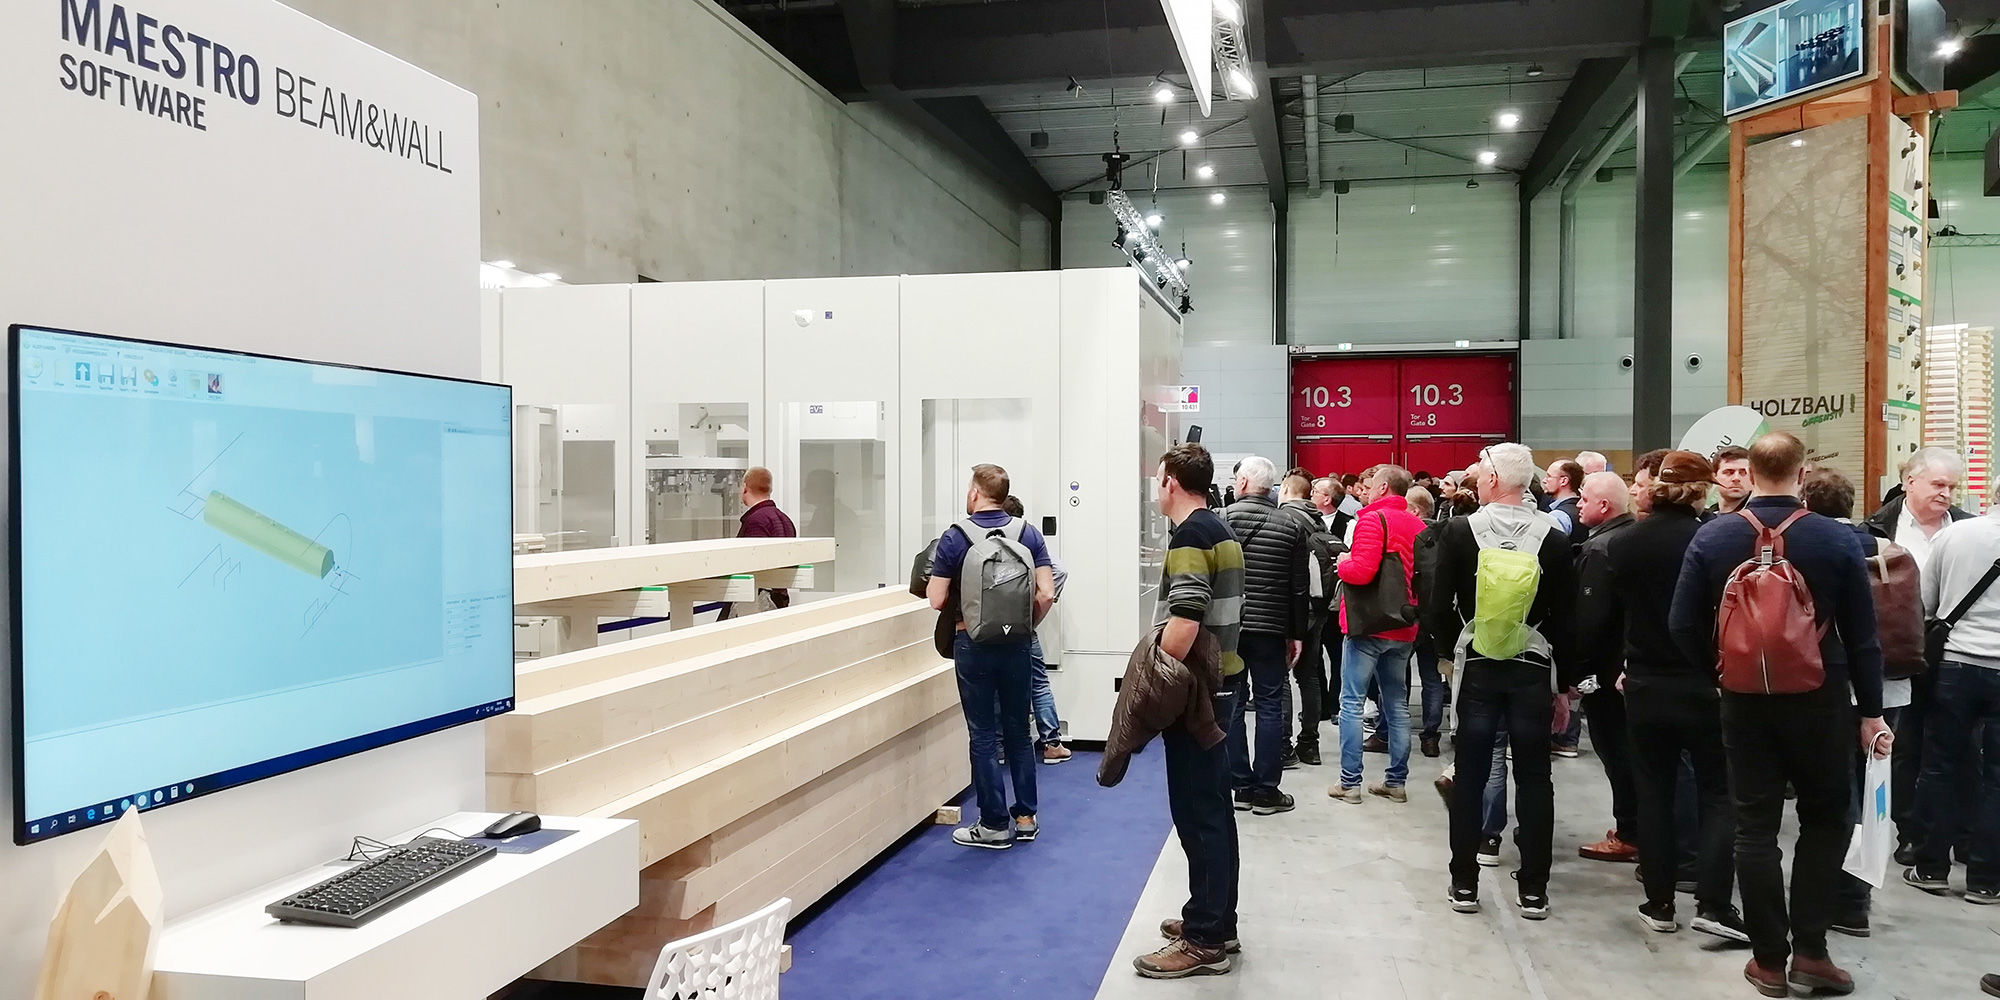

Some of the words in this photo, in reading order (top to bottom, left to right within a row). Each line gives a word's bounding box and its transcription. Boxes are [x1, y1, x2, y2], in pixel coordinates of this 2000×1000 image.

[59, 53, 207, 131] SOFTWARE
[61, 0, 260, 106] MAESTRO
[275, 67, 453, 174] BEAM&WALL
[1300, 386, 1352, 408] 10.3
[1410, 384, 1463, 406] 10.3
[1751, 395, 1844, 417] HOLZBAU
[1317, 415, 1326, 428] 8
[1427, 413, 1437, 426] 8
